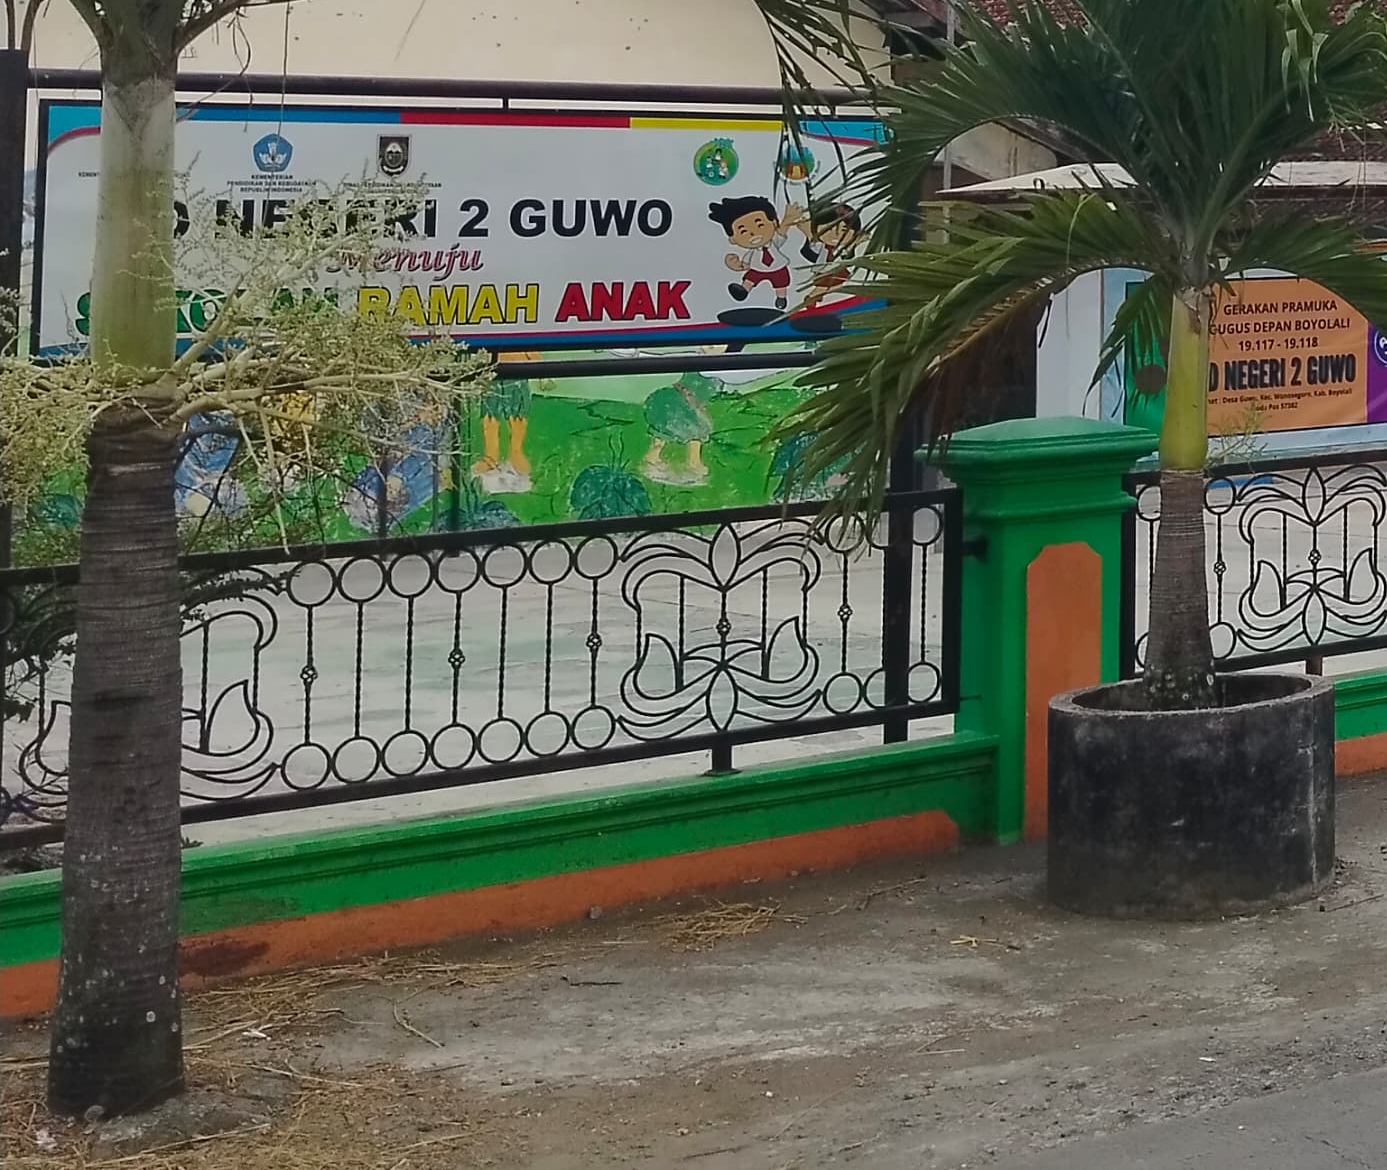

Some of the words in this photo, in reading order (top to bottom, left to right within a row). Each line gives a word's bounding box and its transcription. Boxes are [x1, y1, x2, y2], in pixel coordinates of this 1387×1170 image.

[458, 199, 489, 238] 2
[509, 199, 673, 238] GUWO
[555, 281, 691, 323] ANAK
[1223, 302, 1278, 316] GERAKAN
[1282, 300, 1338, 313] PRAMUKA
[1208, 322, 1251, 336] GUGUS
[1253, 320, 1292, 333] DEPAN
[1295, 317, 1350, 331] BOYOLALI
[1239, 339, 1275, 351] 19.117
[1284, 337, 1318, 349] 19.118
[1224, 357, 1286, 391] NEGERI
[1290, 357, 1302, 386] 2
[1307, 353, 1356, 385] GUWO
